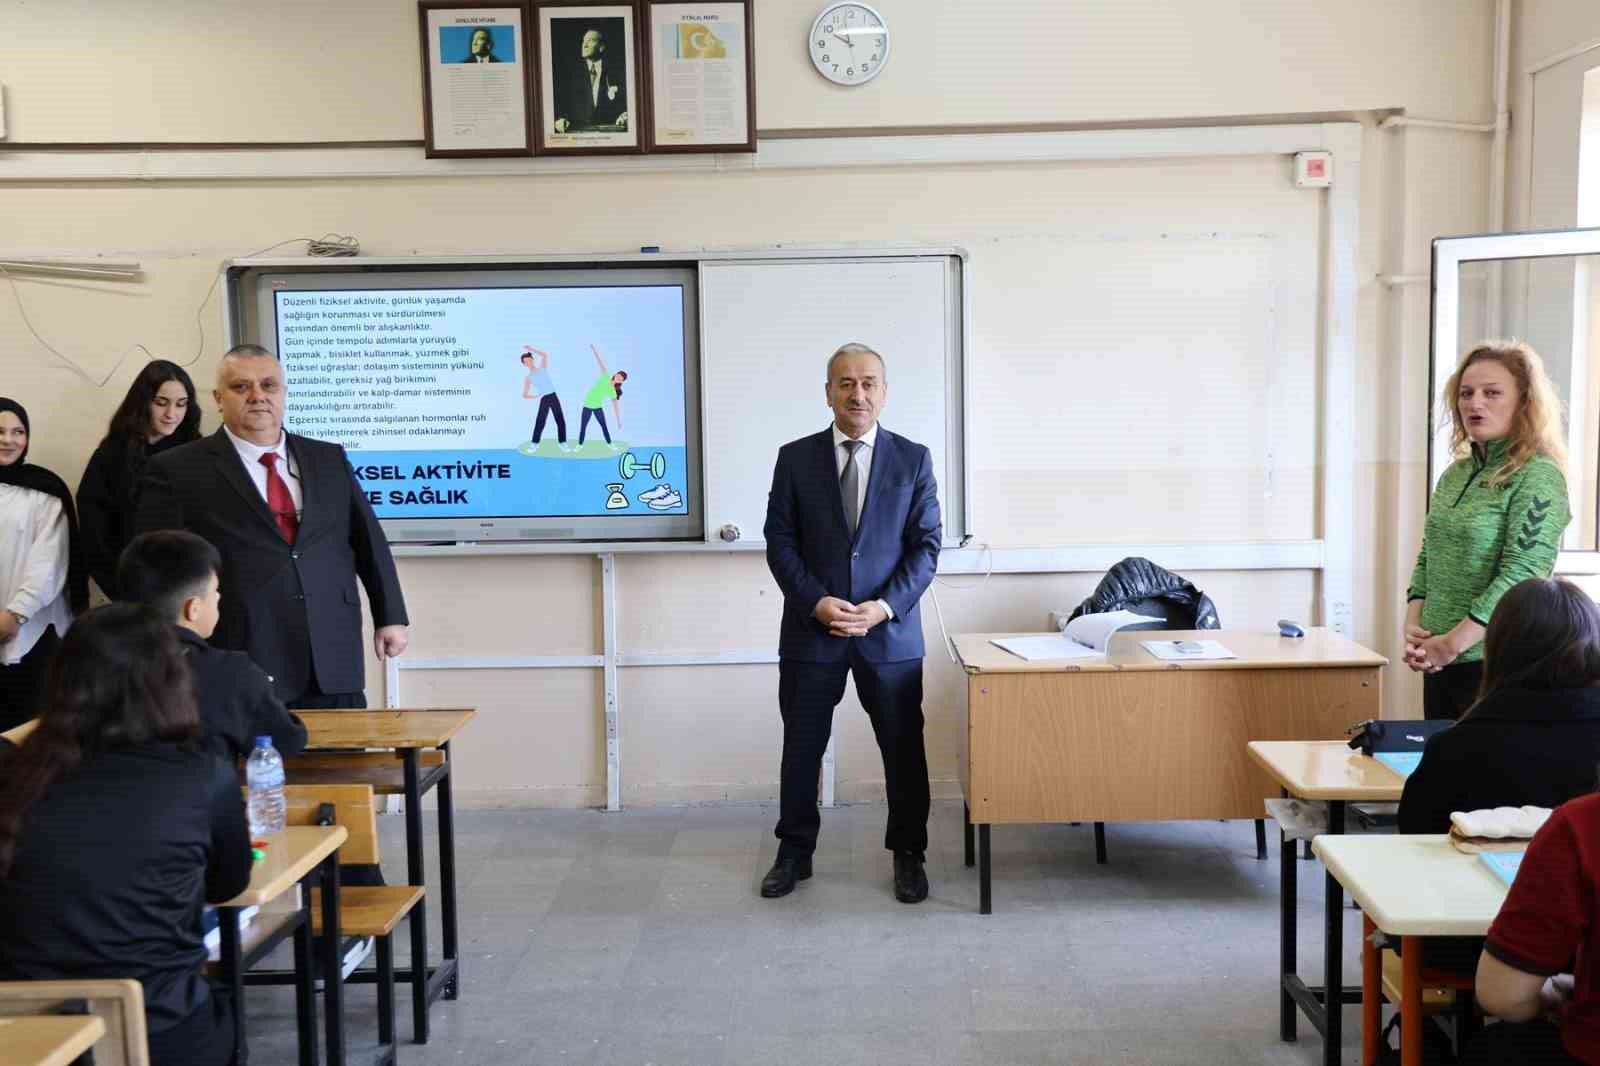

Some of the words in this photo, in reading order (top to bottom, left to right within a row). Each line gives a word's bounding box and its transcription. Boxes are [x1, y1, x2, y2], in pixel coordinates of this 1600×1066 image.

[823, 25, 834, 33] 10
[818, 39, 826, 48] 9
[822, 54, 830, 63] 8
[832, 63, 839, 72] 7
[846, 67, 854, 76] 6
[862, 63, 869, 72] 5
[471, 413, 487, 422] ruh
[352, 465, 406, 480] KSEL
[412, 460, 510, 480] AKTİVİTE
[389, 486, 468, 505] SAĞLIK
